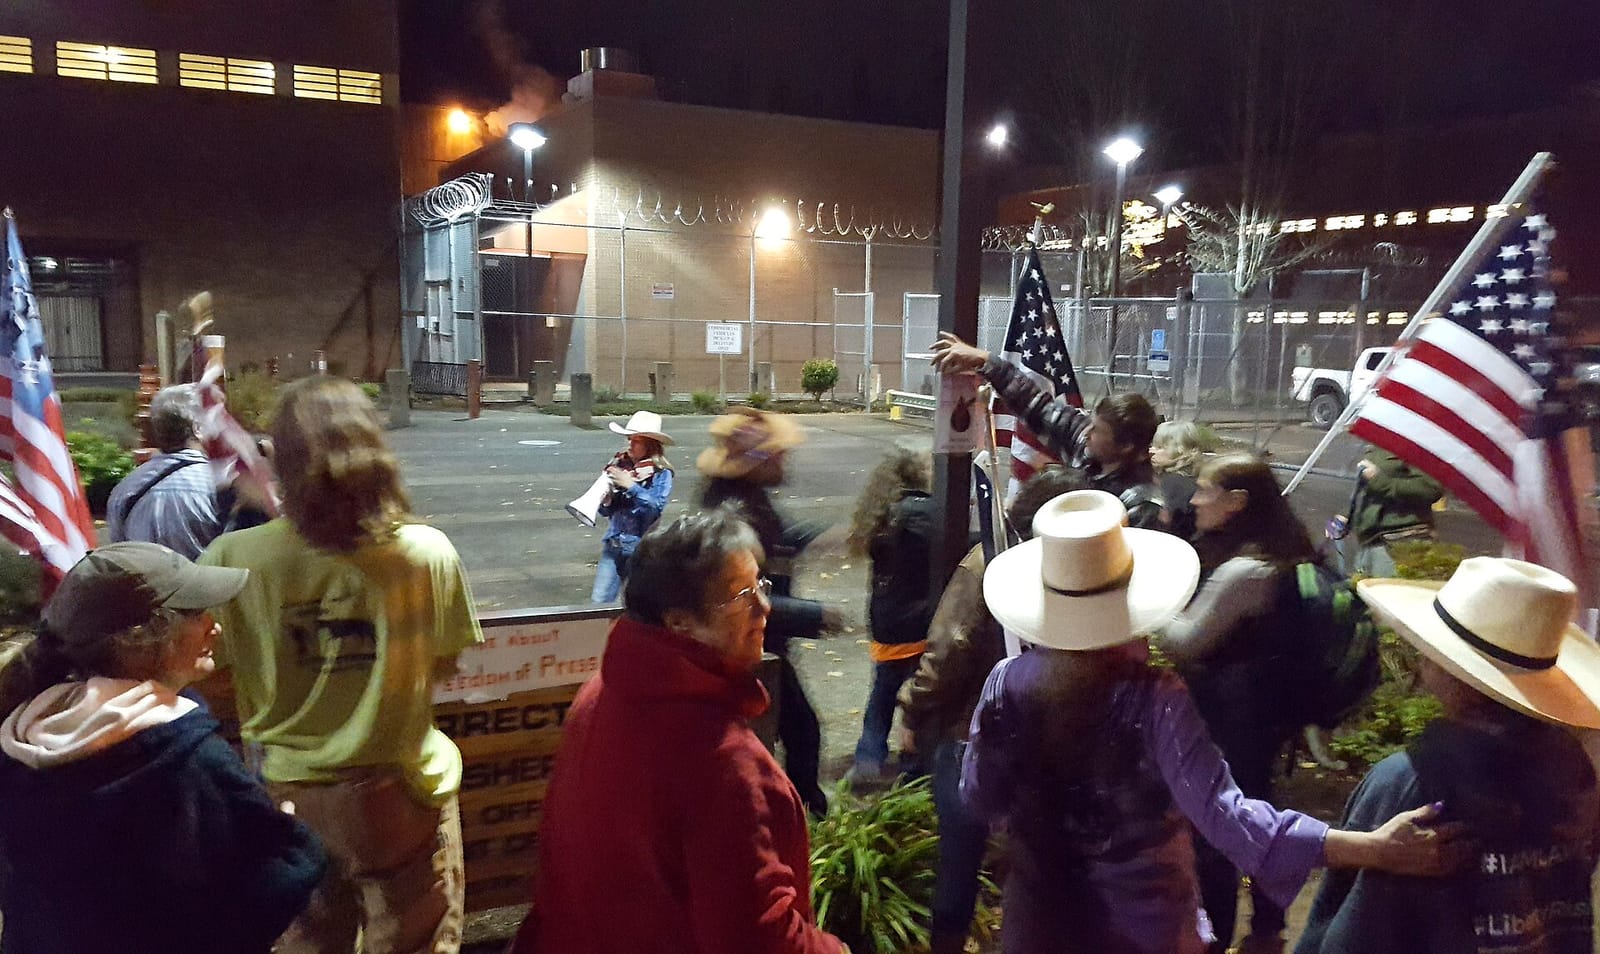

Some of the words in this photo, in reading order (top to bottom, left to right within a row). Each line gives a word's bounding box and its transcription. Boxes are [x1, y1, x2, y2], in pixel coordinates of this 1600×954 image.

[514, 662, 533, 682] of
[540, 654, 599, 680] Press
[434, 701, 571, 738] RRECT
